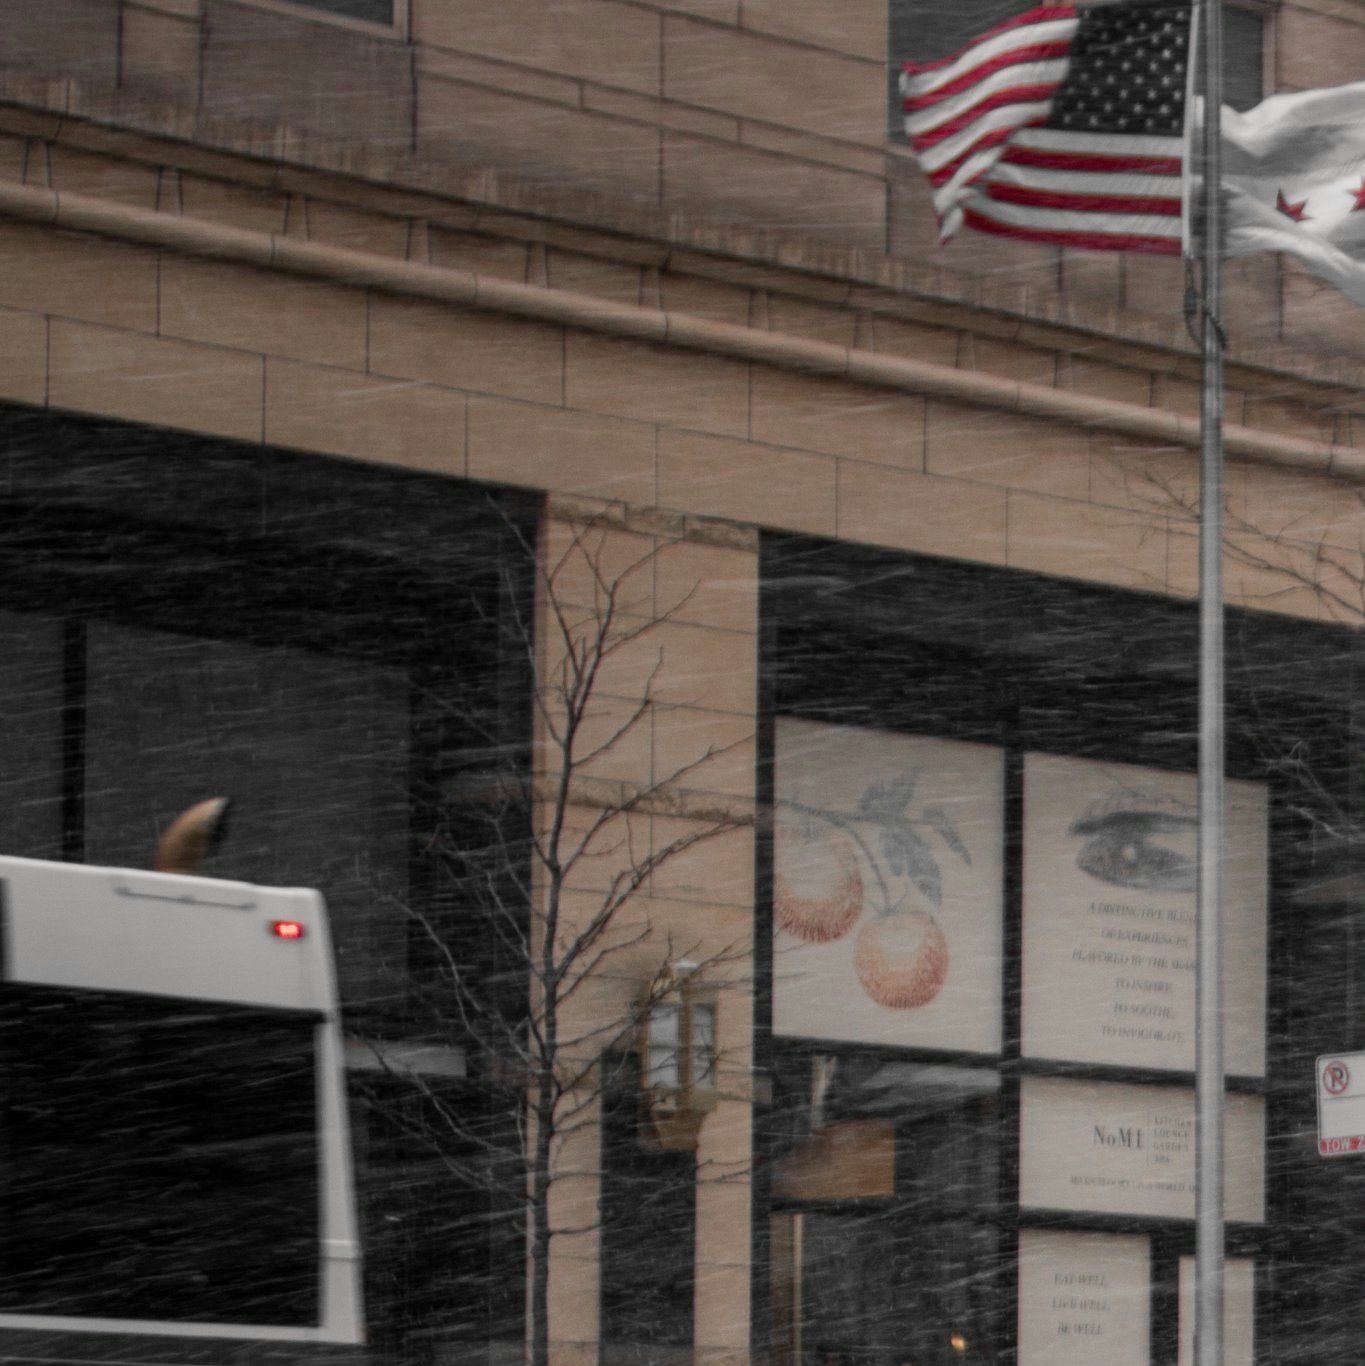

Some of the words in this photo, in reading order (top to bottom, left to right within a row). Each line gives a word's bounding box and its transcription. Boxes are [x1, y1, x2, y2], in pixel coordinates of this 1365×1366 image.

[1326, 1136, 1350, 1153] TOW
[1077, 1273, 1107, 1288] WELL
[1079, 1298, 1110, 1312] WELL
[1074, 1322, 1105, 1336] WELL
